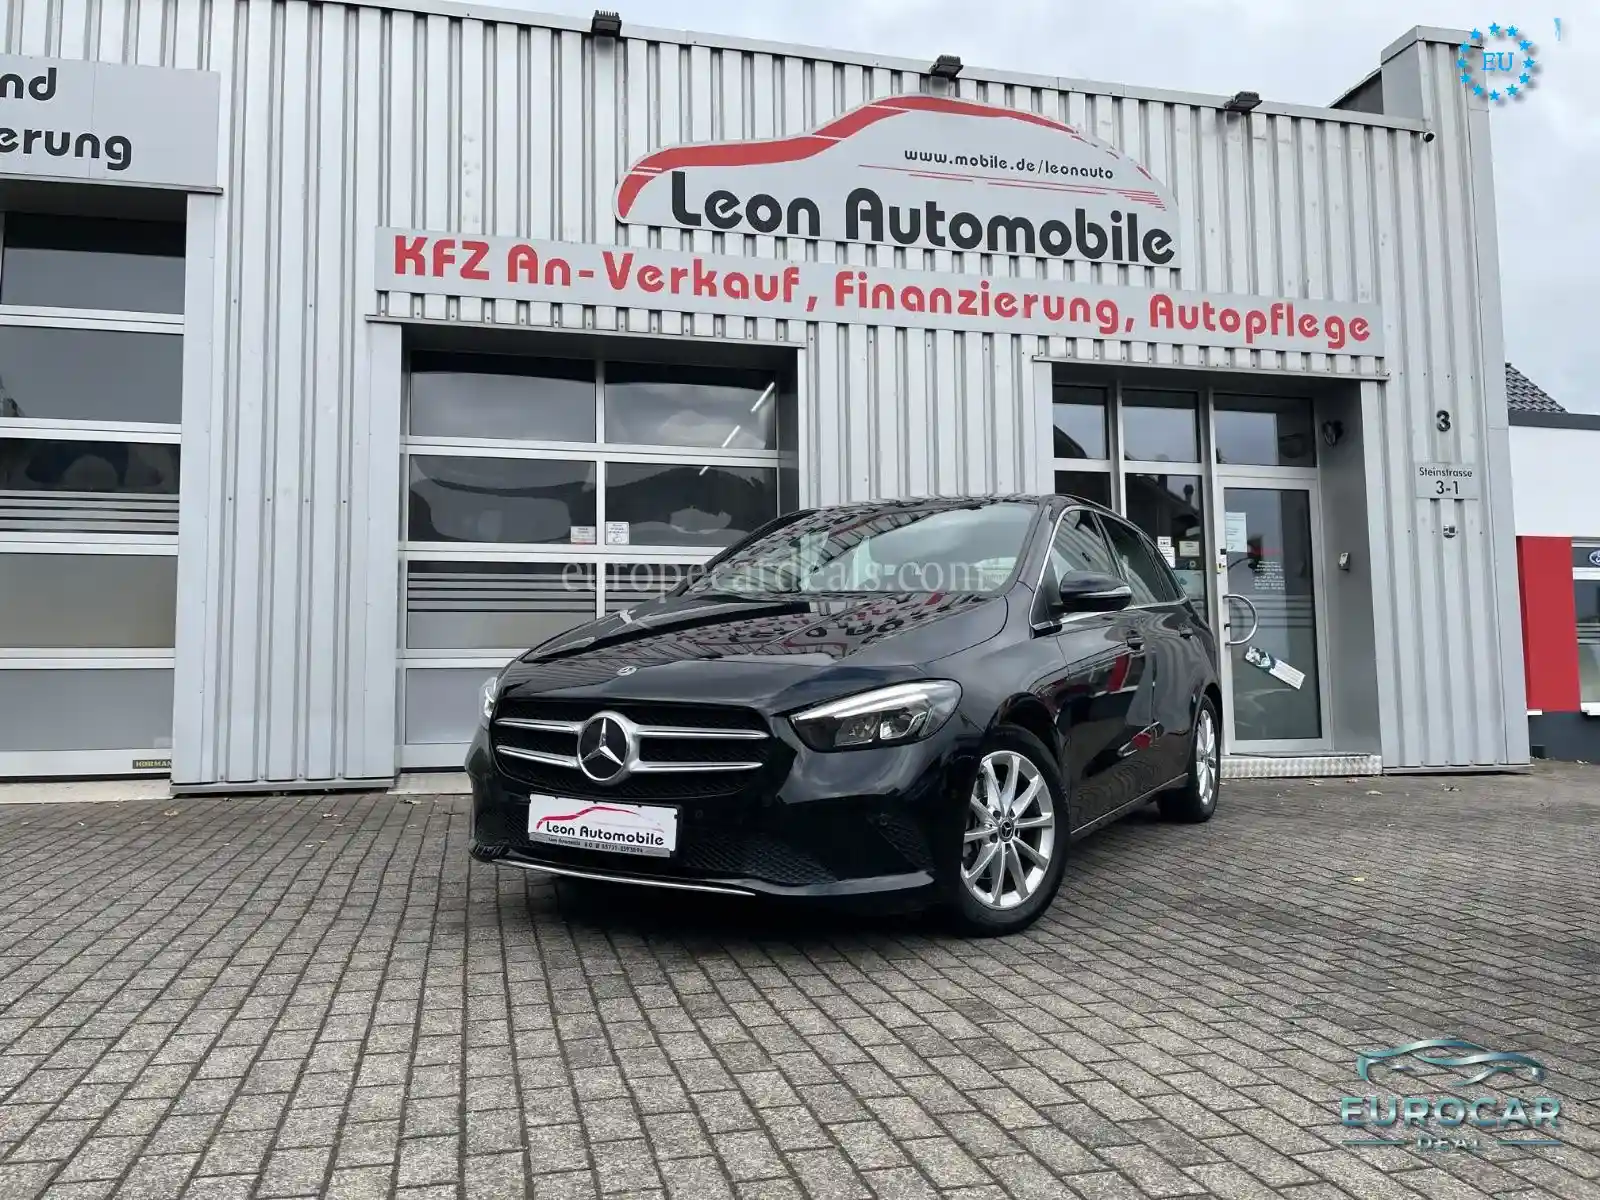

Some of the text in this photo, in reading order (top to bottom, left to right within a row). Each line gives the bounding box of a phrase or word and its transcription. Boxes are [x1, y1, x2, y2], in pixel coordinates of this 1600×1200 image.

[0, 67, 57, 101] nd
[0, 127, 132, 171] erung
[904, 149, 1114, 180] www.mobile.de/leonauto
[671, 171, 1176, 265] Leon Automobile
[394, 235, 1371, 350] KFZ An-Verkauf, Finanzierung, Autopflege
[1436, 410, 1451, 432] 3
[1419, 466, 1473, 478] Steinstrasse
[1435, 480, 1459, 495] 3-1
[546, 821, 665, 846] Leon Automobile
